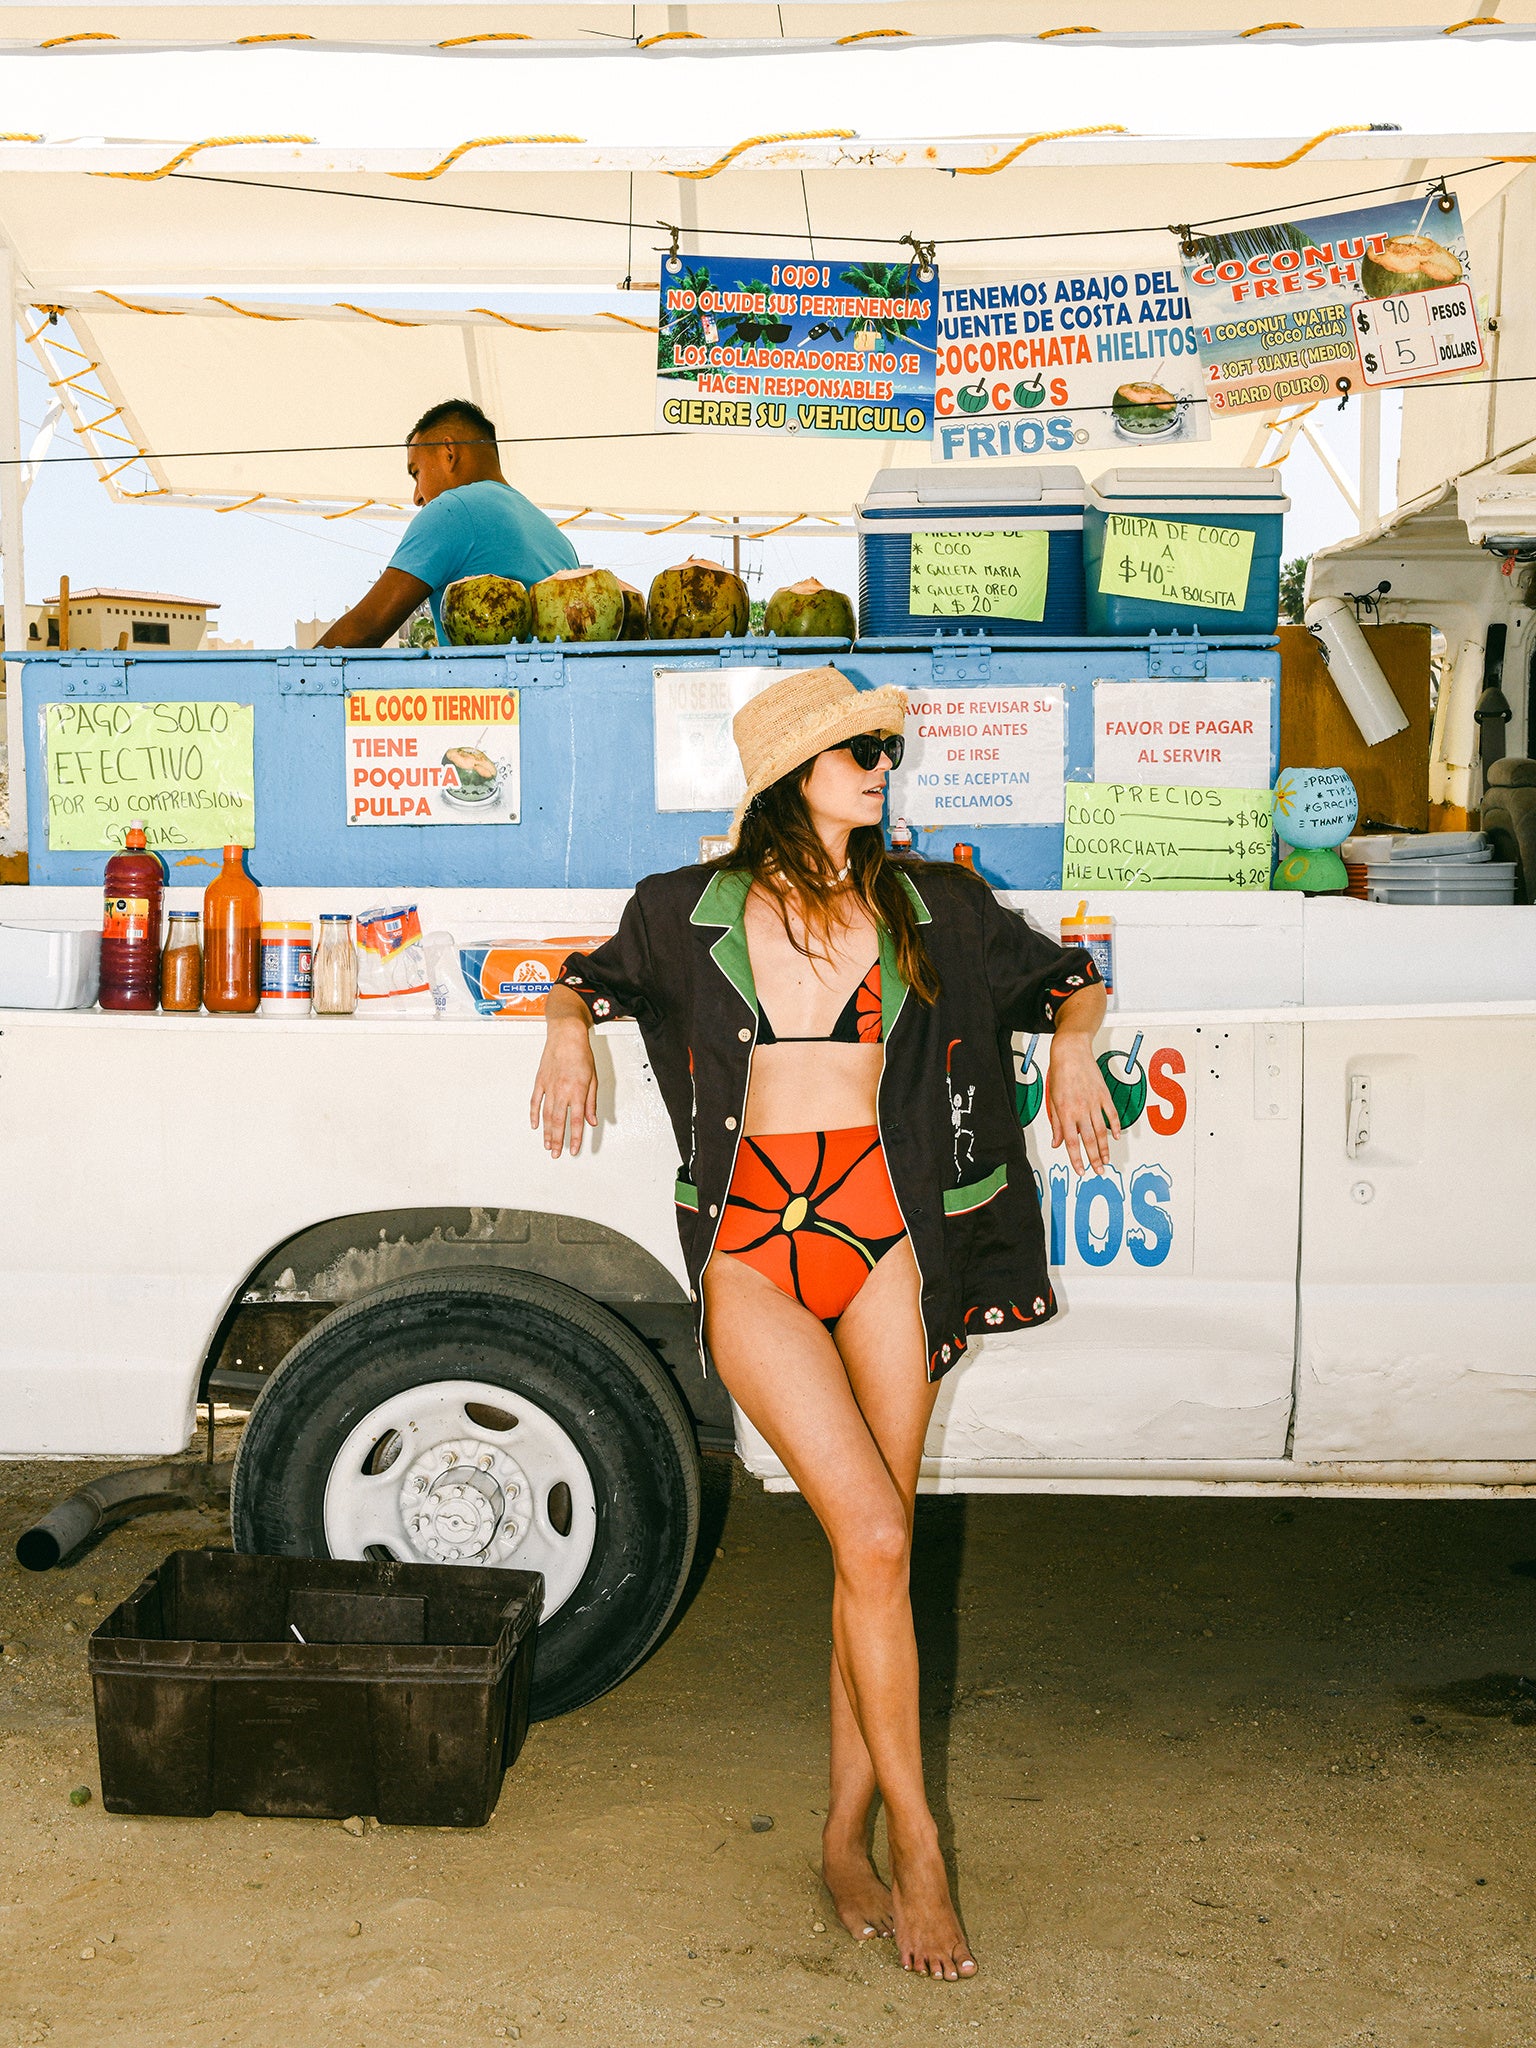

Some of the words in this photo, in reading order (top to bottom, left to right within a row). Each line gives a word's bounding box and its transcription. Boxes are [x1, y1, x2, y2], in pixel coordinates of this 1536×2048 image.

[1192, 232, 1388, 286] COCONUT
[942, 282, 1047, 312] TENEMOS
[1054, 274, 1128, 303] ABAJO
[1134, 271, 1179, 296] DEL
[1231, 262, 1357, 303] FRESH
[667, 290, 696, 311] NO
[699, 291, 765, 313] OLVIDE
[768, 294, 797, 315] SUS
[800, 296, 931, 319] PERTENENCIAS
[1023, 309, 1054, 334] DE
[1060, 303, 1133, 330] COSTA
[1202, 327, 1213, 343] 1
[1216, 315, 1287, 341] COCONUT
[1293, 304, 1347, 327] WATER
[1357, 310, 1370, 335] $
[1382, 300, 1410, 325] 90
[1431, 301, 1467, 321] PESOS
[1261, 328, 1302, 350] (COCO
[1305, 320, 1347, 340] AGUA)
[673, 345, 706, 366] LOS
[709, 347, 865, 371] COLABORADORES
[868, 353, 897, 373] NO
[900, 354, 920, 374] SE
[936, 335, 1093, 376] COCORCHATA
[1096, 326, 1198, 363] HIELITOS
[1364, 353, 1378, 374] $
[1395, 338, 1416, 365] 5
[1439, 340, 1477, 360] DOLLARS
[1209, 365, 1220, 381] 2
[1222, 359, 1253, 379] SOFT
[1258, 351, 1299, 373] SUAVE
[697, 374, 760, 395] HACEN
[763, 377, 894, 400] RESPONSABLES
[1214, 392, 1225, 408] 3
[1227, 384, 1271, 407] HARD
[1274, 374, 1329, 401] (DURO)
[663, 398, 751, 426] CIERRE
[756, 402, 786, 428] SU
[798, 404, 926, 433] VEHICULO
[940, 415, 1074, 460] FRIOS
[1110, 515, 1158, 538] PULPA
[1167, 523, 1188, 540] DE
[1199, 527, 1240, 547] COCO
[934, 542, 971, 555] COCO
[1161, 544, 1175, 561] A
[926, 563, 977, 576] GALLETA
[984, 565, 1021, 578] MARIA
[927, 584, 979, 596] GALLETA
[985, 583, 1017, 597] OREO
[1162, 584, 1178, 598] LA
[1181, 586, 1236, 606] BOLSITA
[932, 603, 943, 614] A
[50, 703, 132, 736] PAGO
[153, 703, 228, 733] SOLO
[350, 696, 371, 721] EL
[376, 695, 427, 722] COCO
[432, 695, 515, 721] TIERNITO
[904, 702, 942, 716] AVOR
[946, 702, 965, 715] DE
[969, 700, 1029, 714] REVISAR
[1033, 700, 1052, 713] SU
[918, 724, 978, 738] CAMBIO
[982, 723, 1028, 736] ANTES
[1105, 721, 1163, 736] FAVOR
[1169, 721, 1190, 735] DE
[1195, 720, 1254, 734] PAGAR
[353, 738, 418, 757] TIENE
[947, 749, 965, 761] DE
[970, 748, 1000, 760] IRSE
[1137, 749, 1158, 763] AL
[1163, 749, 1222, 762] SERVIR
[54, 745, 203, 784] EFECTIVO
[353, 767, 459, 790] POQUITA
[918, 774, 940, 786] NO
[943, 773, 960, 785] SE
[964, 772, 1030, 785] ACEPTAN
[50, 793, 84, 815] POR
[95, 795, 119, 812] SU
[128, 788, 243, 811] COMPRENSION
[354, 797, 432, 816] PULPA
[935, 795, 1013, 808] RECLAMOS
[1107, 785, 1222, 807] PRECIOS
[1312, 798, 1357, 812] GRACIAS
[1067, 805, 1115, 825] COCO
[1310, 816, 1343, 827] THANK
[1065, 834, 1179, 857] COCORCHATA
[1066, 862, 1152, 883] HIELITOS
[503, 984, 553, 993] CHEDRA
[1033, 1163, 1173, 1267] IOS
